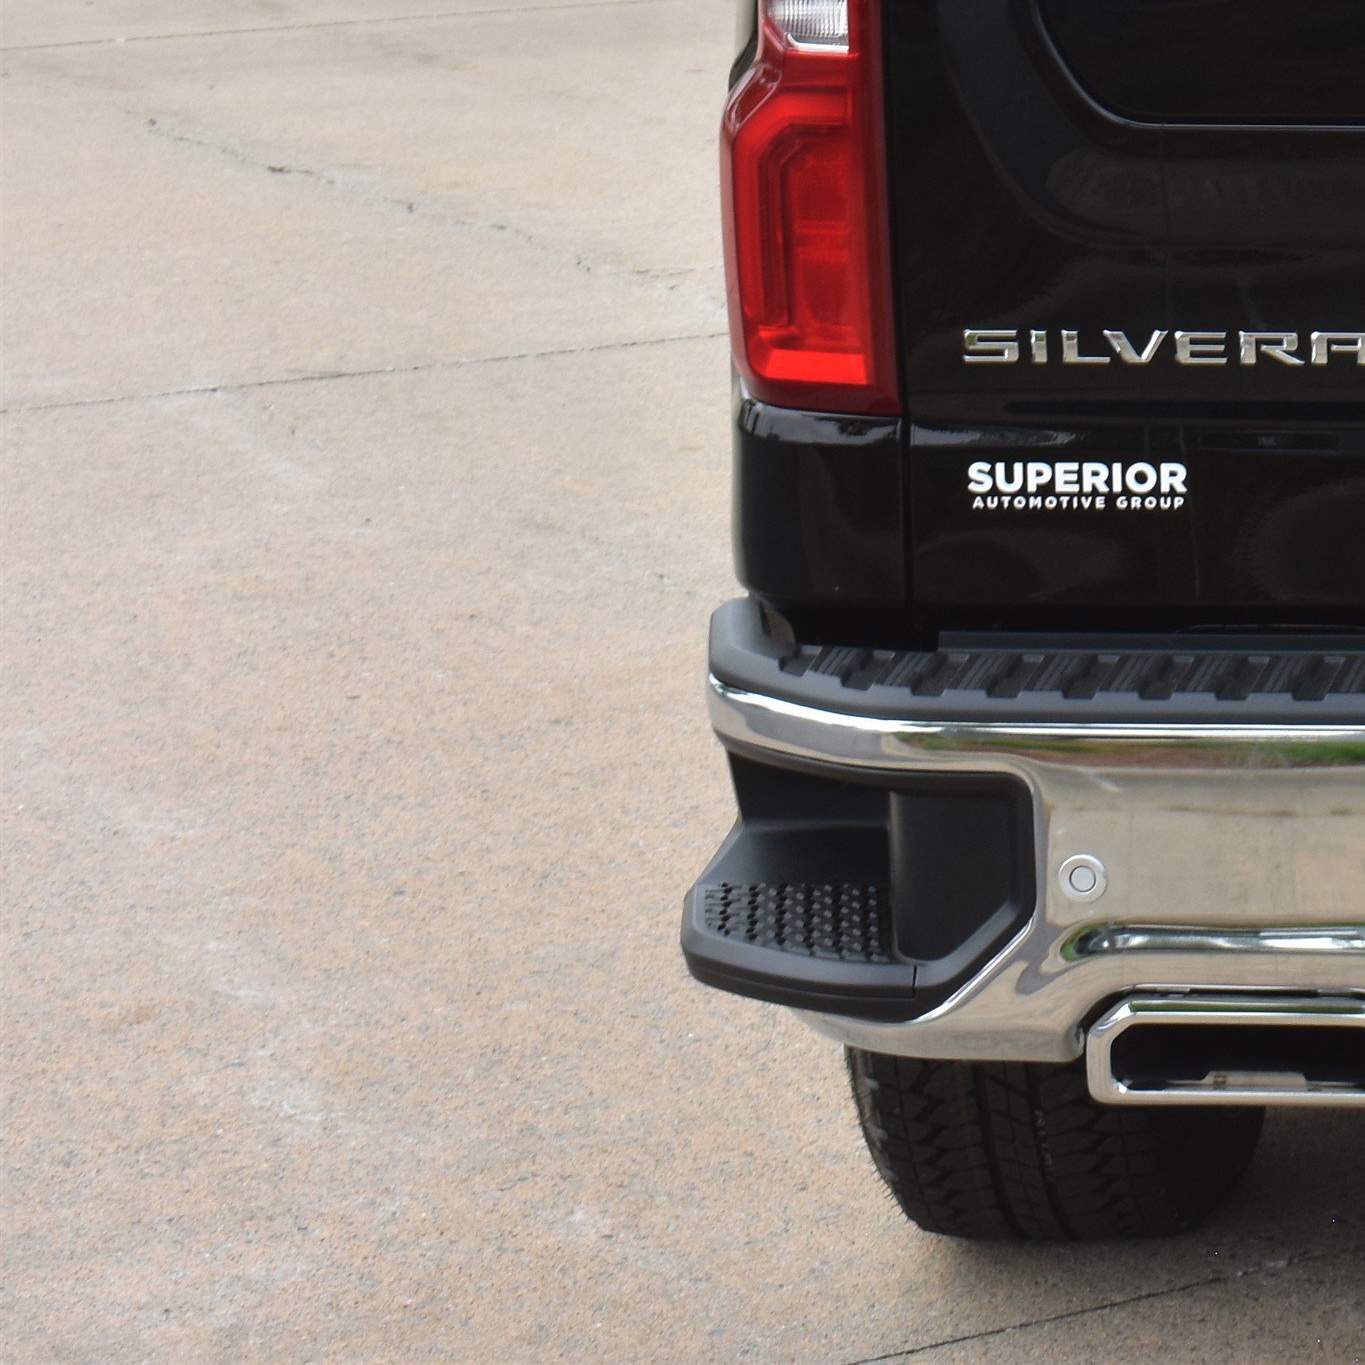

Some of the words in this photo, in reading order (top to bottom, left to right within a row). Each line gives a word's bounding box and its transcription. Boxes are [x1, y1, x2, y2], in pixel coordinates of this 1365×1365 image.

[967, 461, 1188, 495] SUPERIOR
[971, 495, 1106, 511] AUTOMOTIVE
[1115, 495, 1186, 511] GROUP
